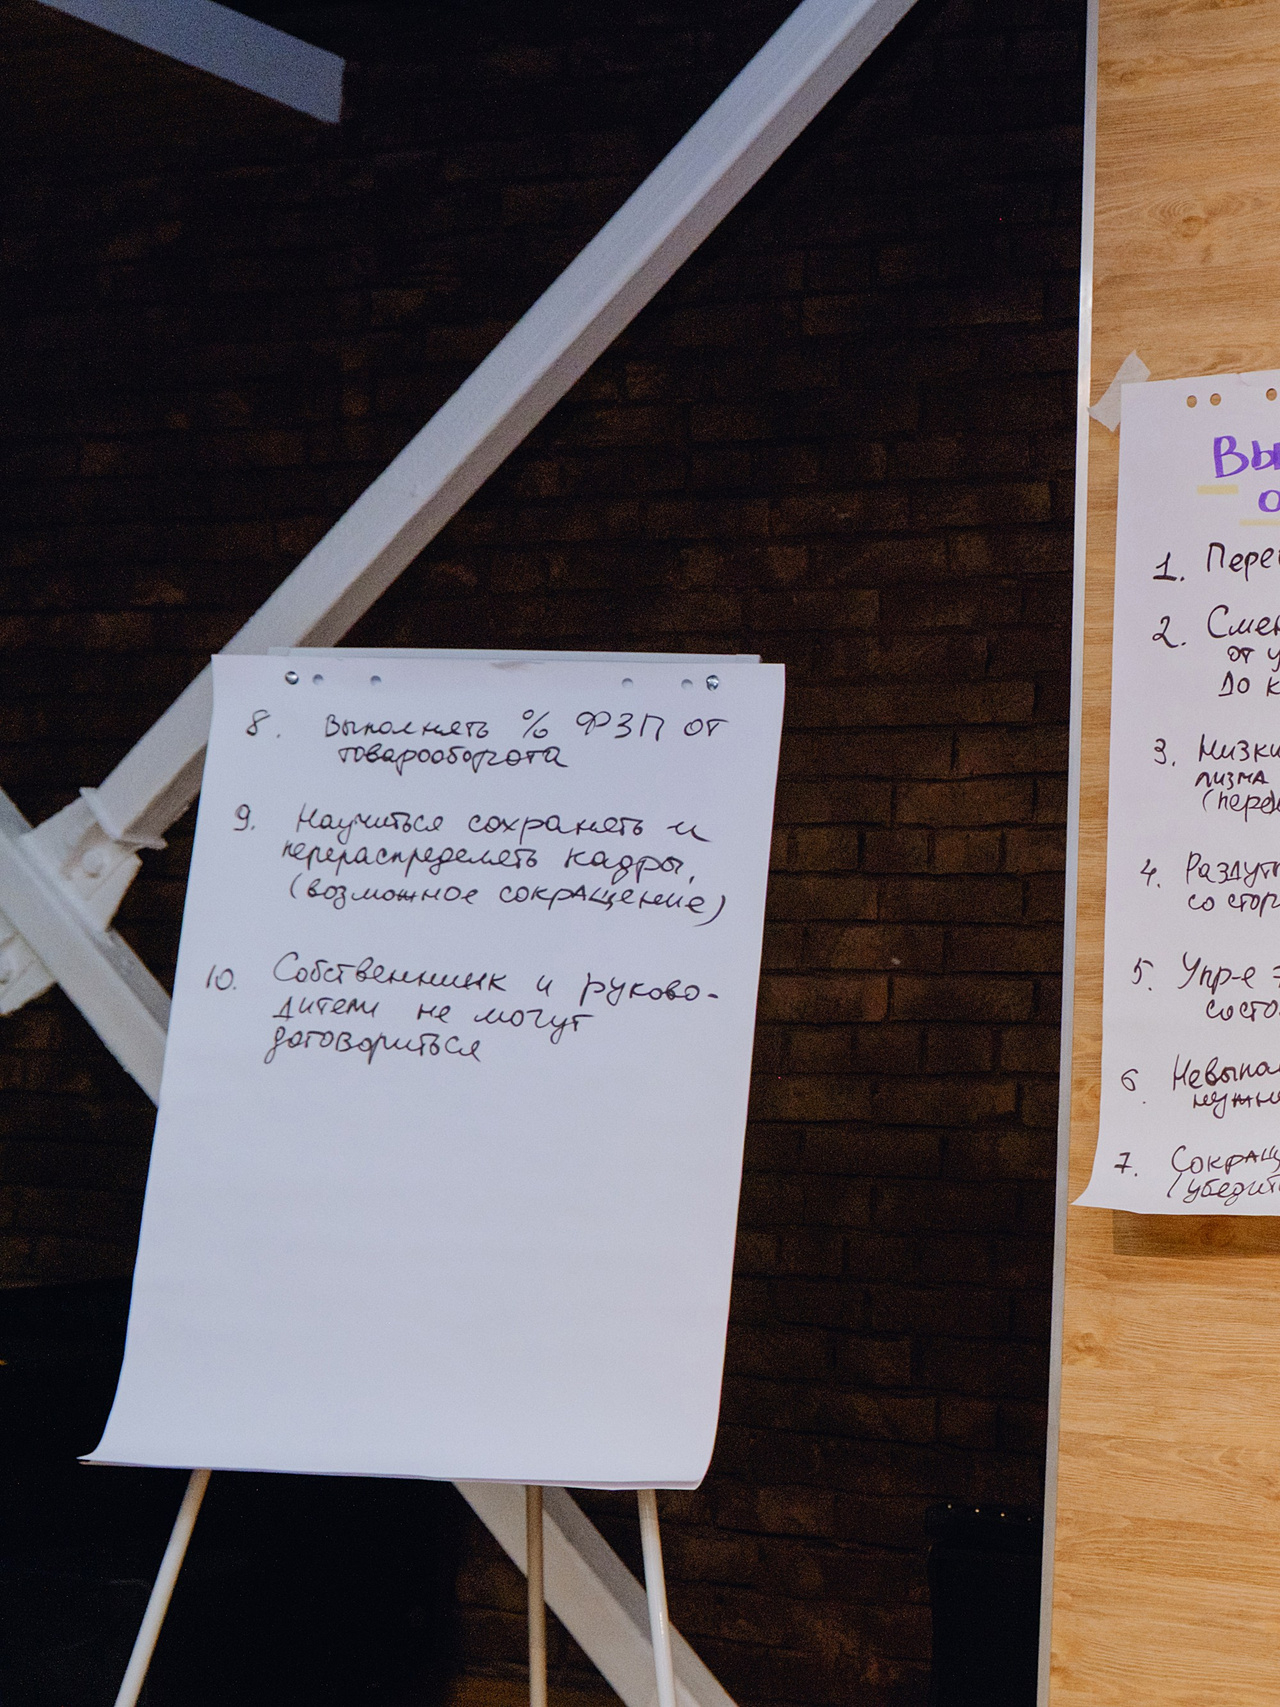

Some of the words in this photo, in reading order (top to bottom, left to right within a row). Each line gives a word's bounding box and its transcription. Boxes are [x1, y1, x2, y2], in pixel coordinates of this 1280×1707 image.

[1152, 552, 1185, 582] 1.
[1151, 615, 1187, 648] 2.
[1226, 645, 1256, 664] от
[245, 709, 281, 739] 8.
[522, 709, 551, 739] %
[337, 742, 569, 776] товарооборота
[1154, 737, 1176, 767] 3.
[1194, 770, 1270, 791] лизма
[233, 803, 256, 832] 9.
[296, 803, 444, 845] Научиться
[467, 814, 644, 845] сохранять
[667, 821, 712, 843] и
[281, 839, 538, 878] перераспределять
[1140, 858, 1162, 889] 4.
[289, 872, 478, 911] (возможное
[499, 884, 727, 928] сокращение)
[1187, 893, 1215, 911] со
[205, 964, 238, 991] 10.
[536, 974, 553, 997] и
[579, 972, 719, 1007] руково-
[1131, 957, 1154, 991] 5.
[1177, 951, 1257, 995] Упр-е
[272, 995, 380, 1020] дители
[417, 1003, 452, 1024] не
[473, 1008, 595, 1045] могут
[263, 1025, 482, 1065] договориться
[1114, 1151, 1139, 1177] 7.
